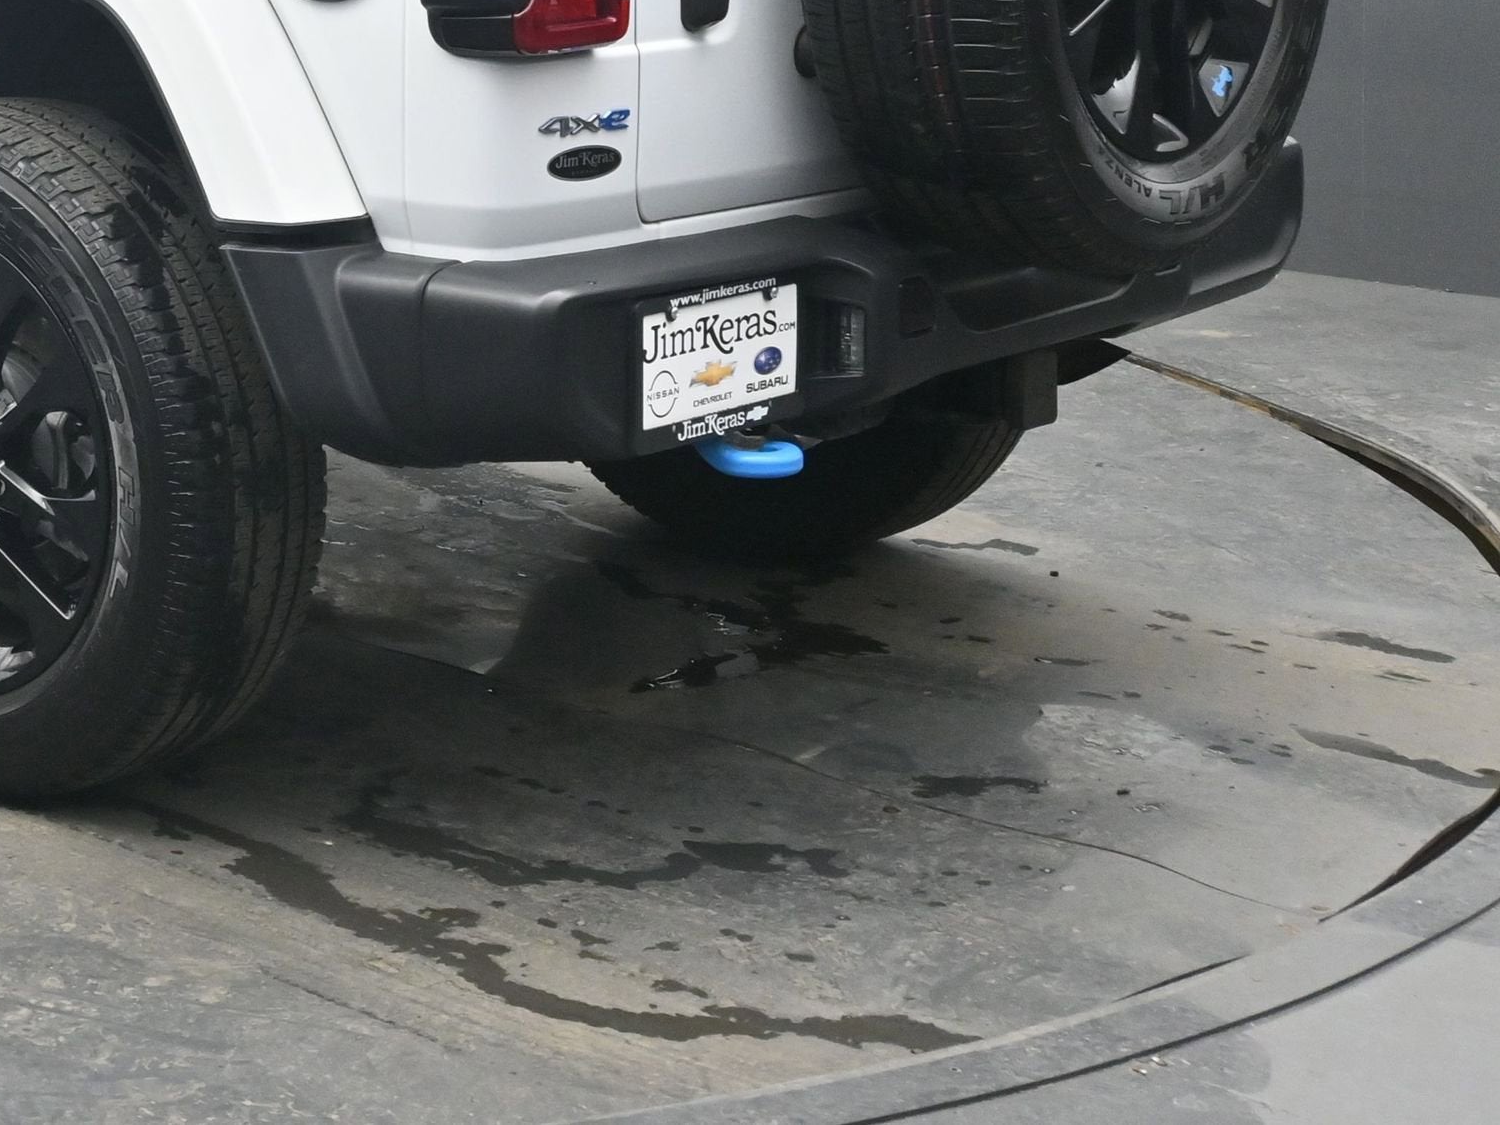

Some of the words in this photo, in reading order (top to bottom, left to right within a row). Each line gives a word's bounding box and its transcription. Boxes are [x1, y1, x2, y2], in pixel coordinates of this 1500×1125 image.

[669, 277, 777, 308] www.jimkeras.com
[745, 374, 789, 394] SUBARU
[646, 386, 681, 402] NISSAN
[692, 391, 733, 408] CHEVROLET
